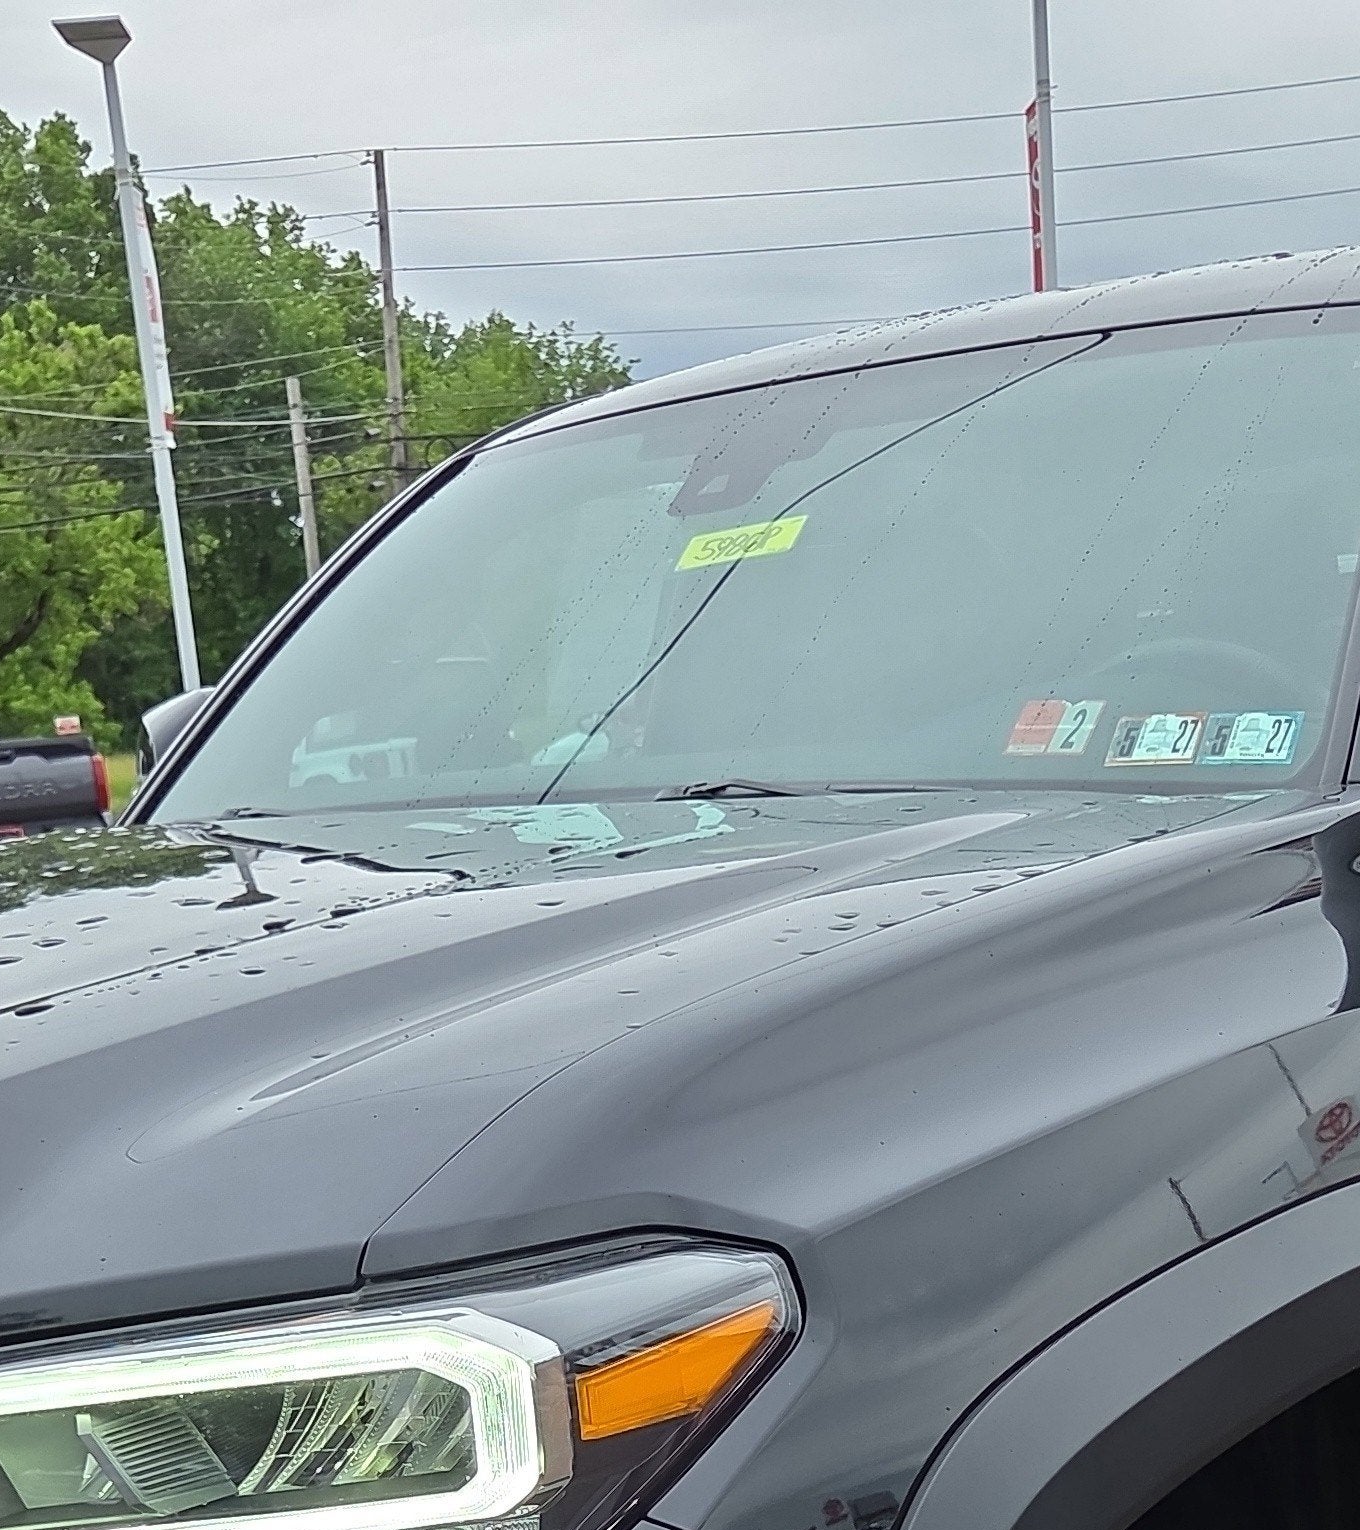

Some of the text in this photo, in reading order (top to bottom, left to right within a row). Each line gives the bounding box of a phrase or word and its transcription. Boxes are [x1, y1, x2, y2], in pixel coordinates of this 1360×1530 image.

[1060, 708, 1087, 749] 2
[1119, 719, 1199, 757] 5 27
[1211, 718, 1293, 756] 5 27
